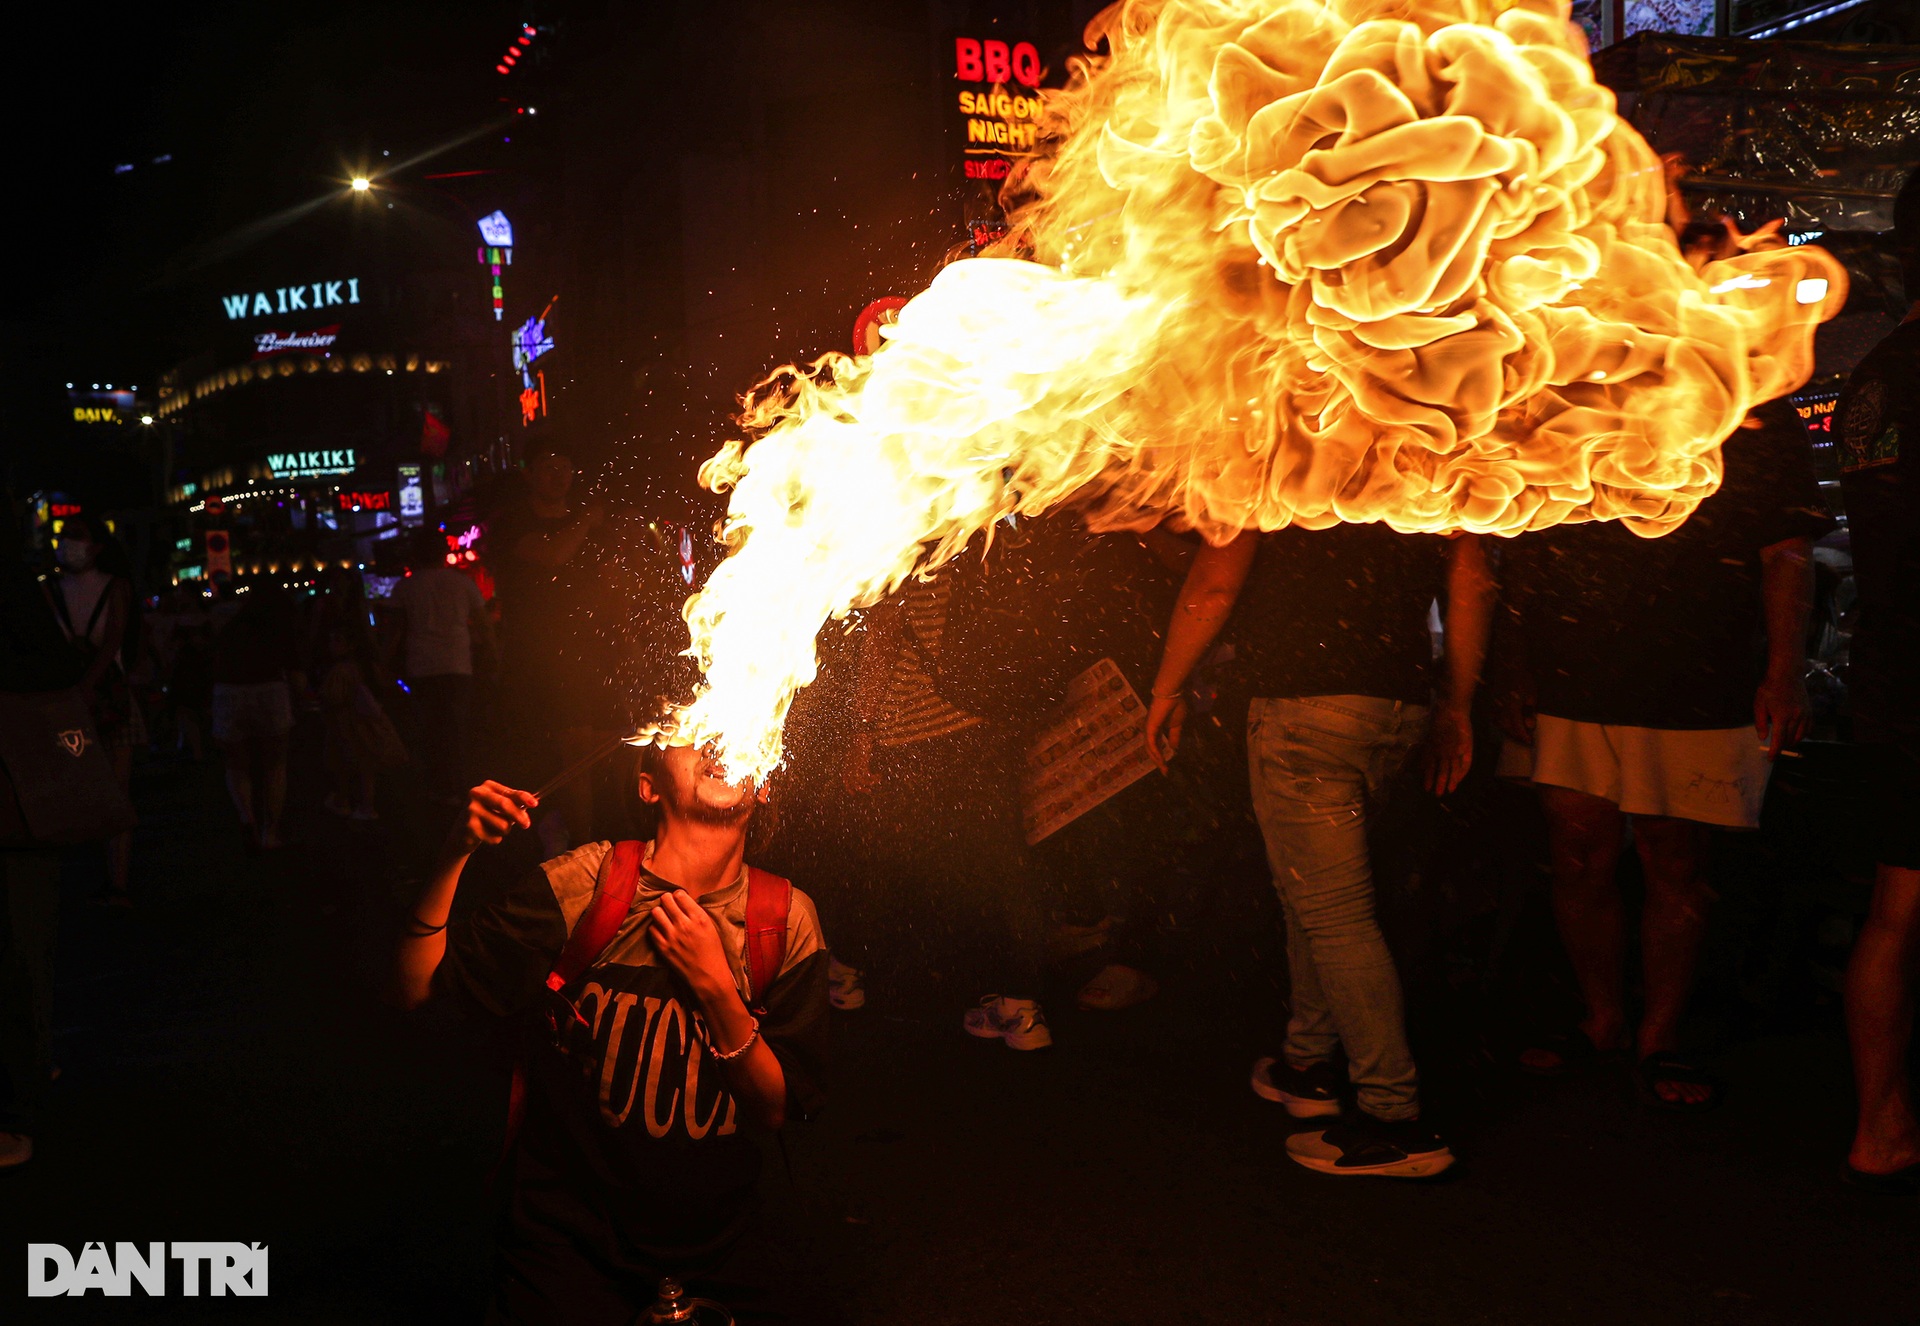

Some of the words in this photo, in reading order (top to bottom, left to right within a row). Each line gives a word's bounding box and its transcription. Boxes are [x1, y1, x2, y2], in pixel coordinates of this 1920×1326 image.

[956, 37, 1041, 87] BBQ
[959, 91, 1044, 119] SAIGON
[967, 119, 1038, 146] NIGHT
[222, 277, 360, 320] WAIKIKI
[254, 331, 336, 352] Budweiser
[267, 449, 356, 470] WAIKIKI
